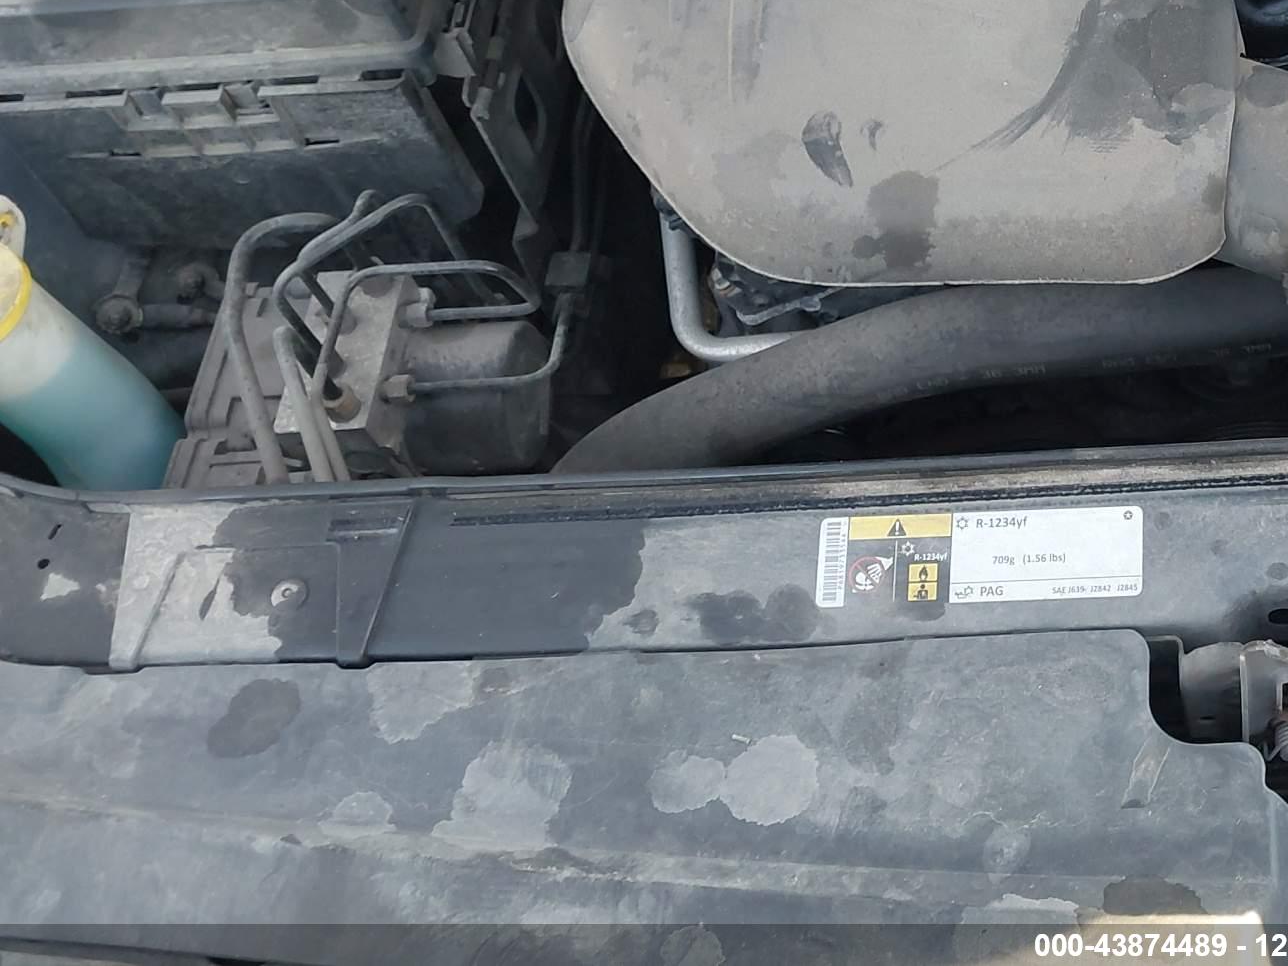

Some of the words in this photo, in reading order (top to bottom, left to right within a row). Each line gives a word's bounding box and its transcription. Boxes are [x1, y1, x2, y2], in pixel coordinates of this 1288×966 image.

[975, 515, 1028, 530] R-1234yf
[913, 551, 948, 562] R-1234yf
[991, 555, 1016, 566] 709g
[1022, 554, 1047, 565] (1.56
[1048, 552, 1067, 564] lbs)
[979, 585, 1004, 597] PAG
